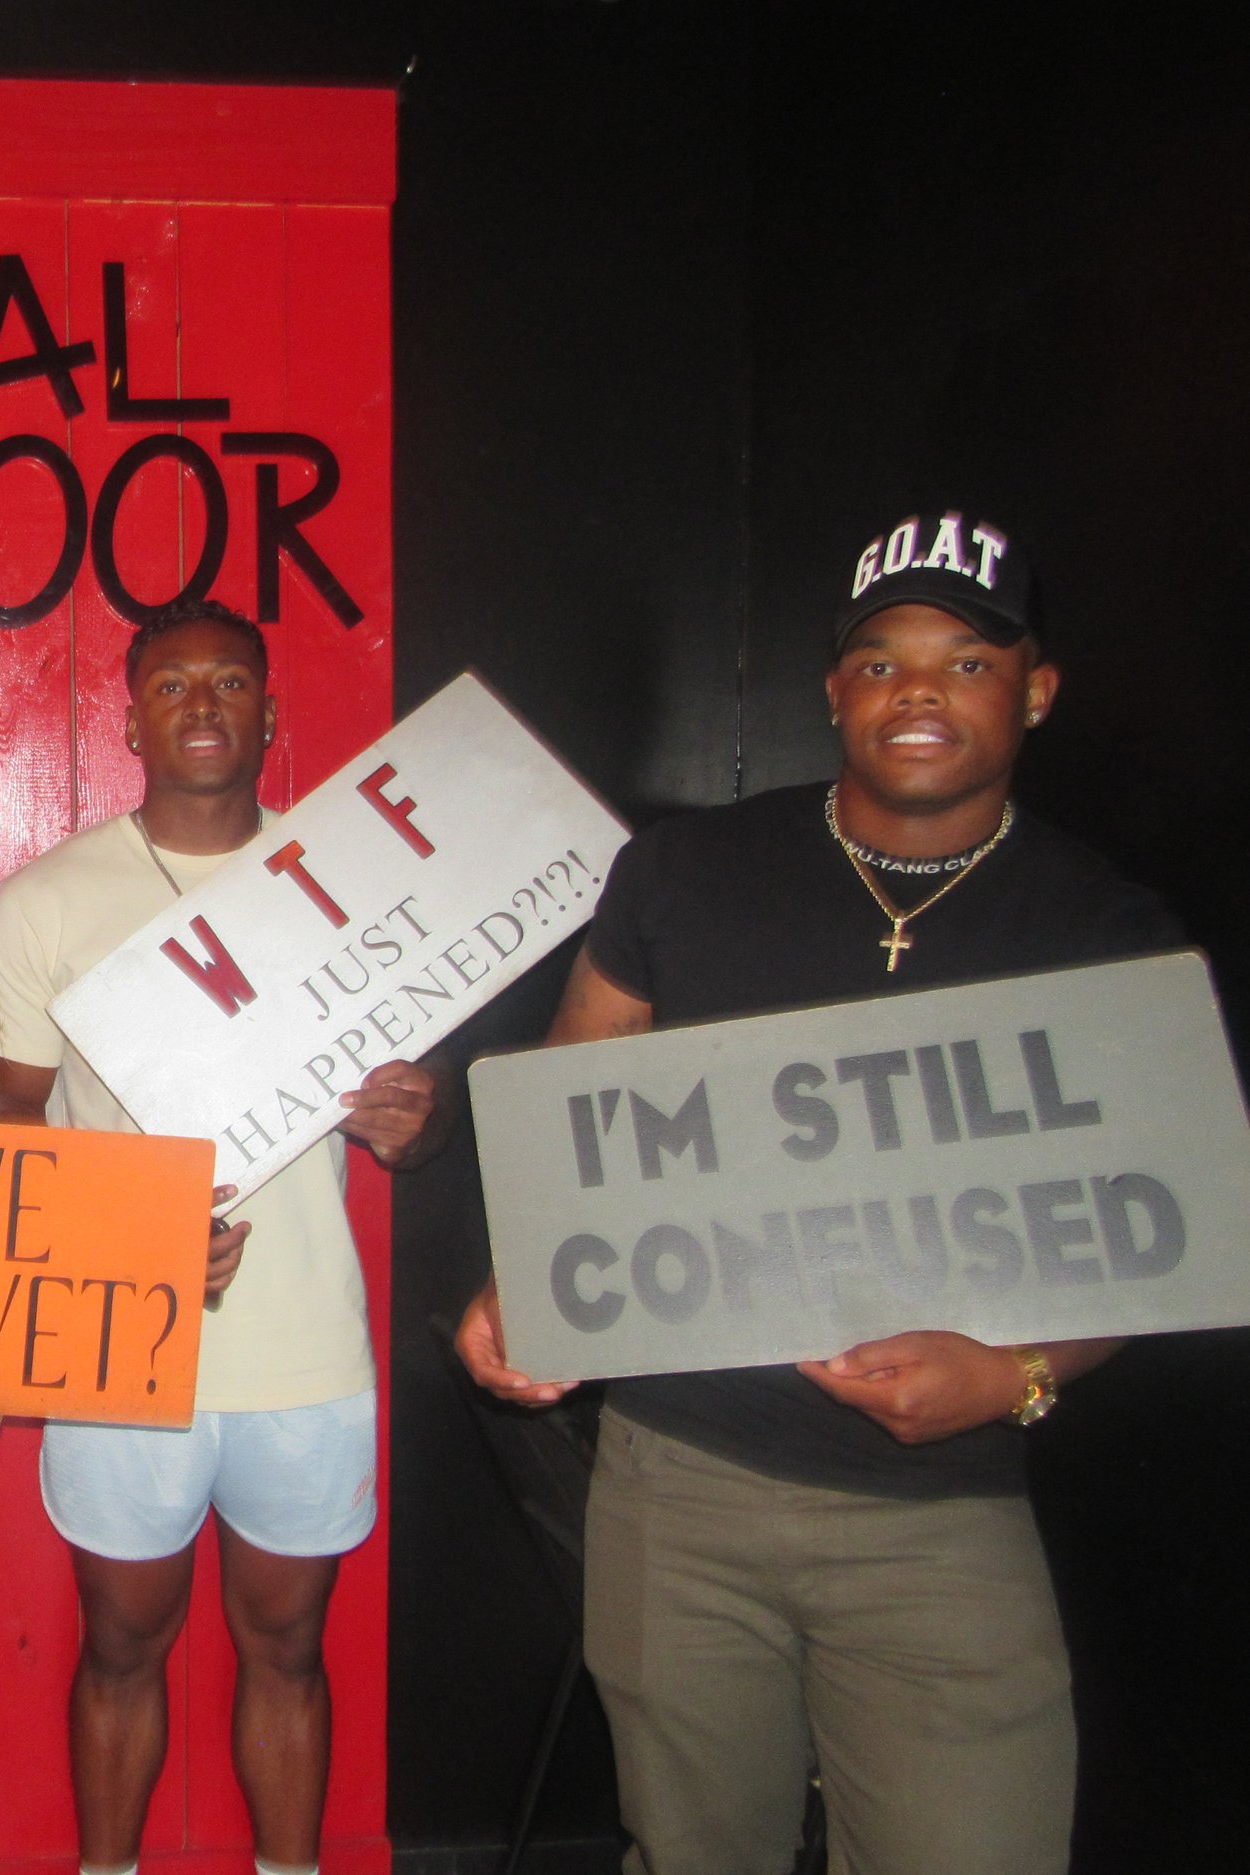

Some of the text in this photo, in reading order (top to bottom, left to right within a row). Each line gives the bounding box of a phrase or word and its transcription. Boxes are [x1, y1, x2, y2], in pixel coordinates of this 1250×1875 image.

[221, 849, 600, 1165] HAPPENED?!?!
[297, 895, 433, 1021] JUST
[567, 1029, 1102, 1188] I'M STILL
[550, 1172, 1187, 1333] CONFUSED
